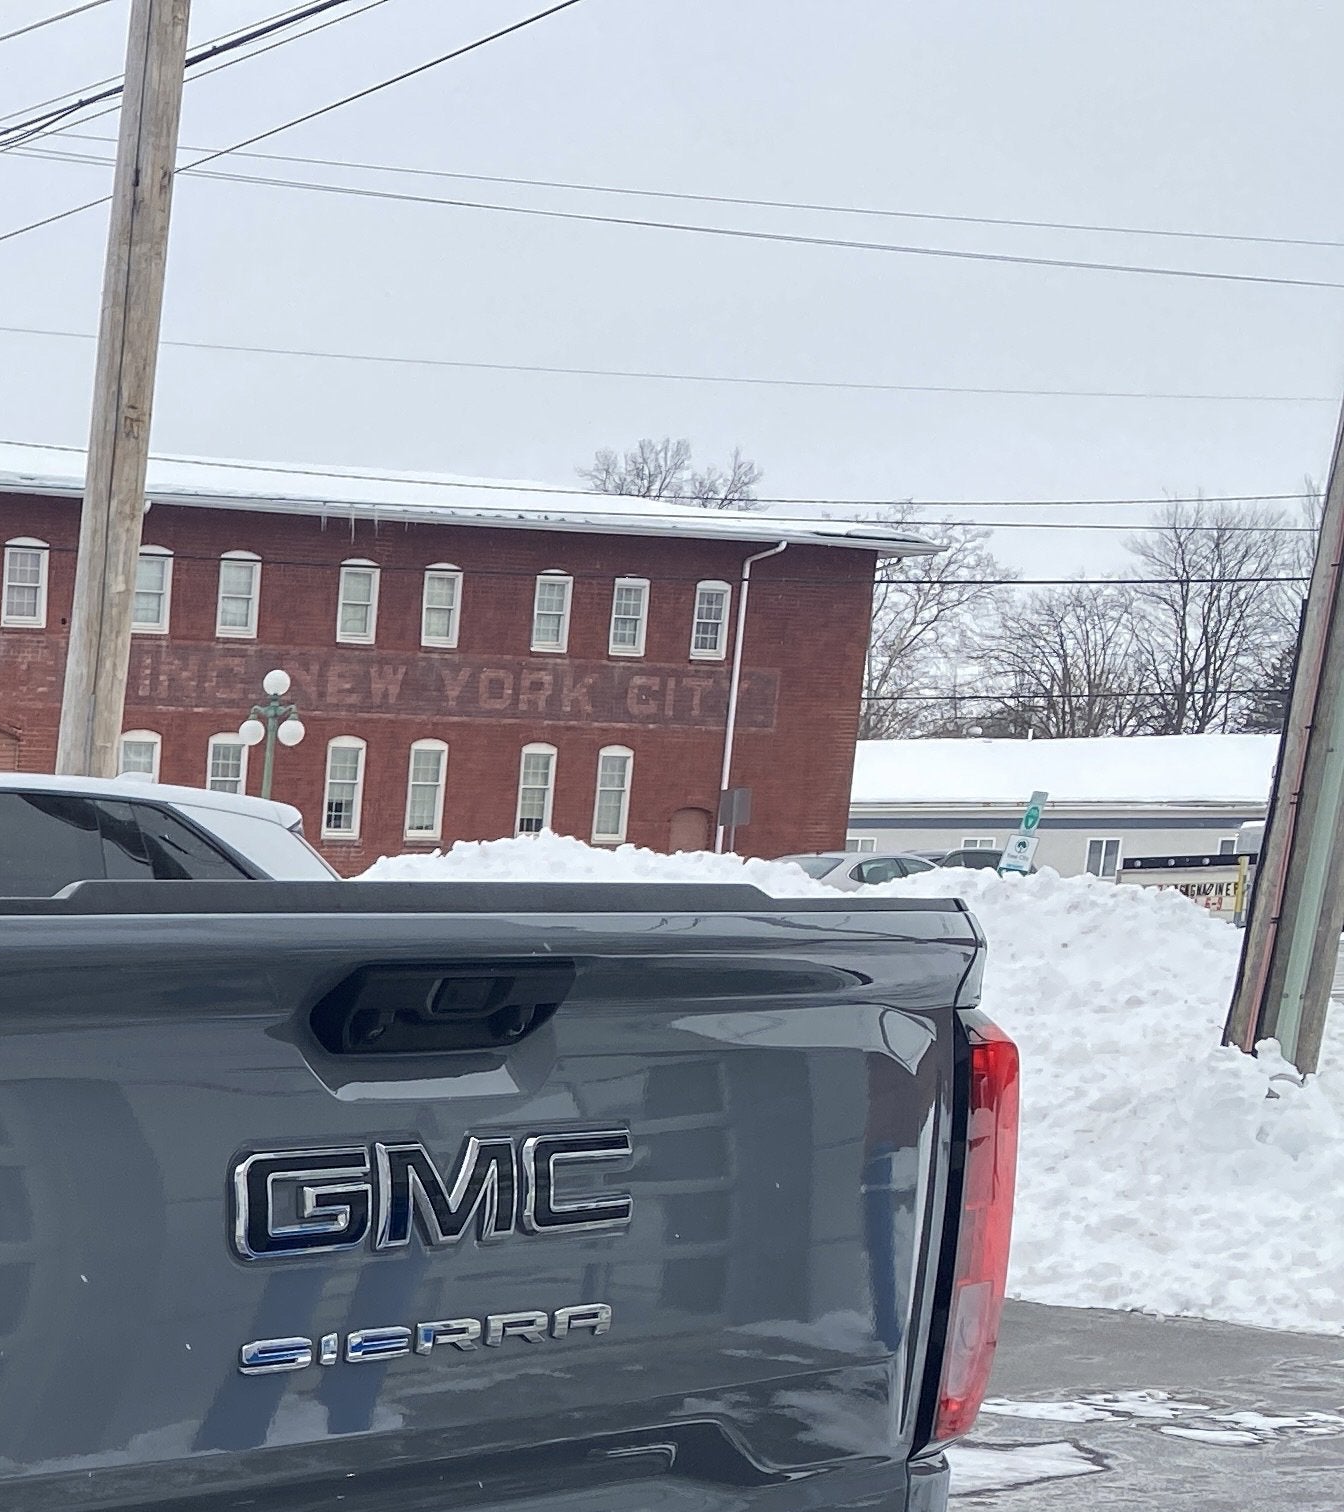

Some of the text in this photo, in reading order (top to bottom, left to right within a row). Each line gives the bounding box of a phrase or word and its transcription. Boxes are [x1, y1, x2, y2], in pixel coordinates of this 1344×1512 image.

[280, 659, 408, 703] NEW
[441, 667, 600, 719] YORK
[232, 1128, 633, 1261] GMC
[238, 1302, 613, 1376] SIERRA
